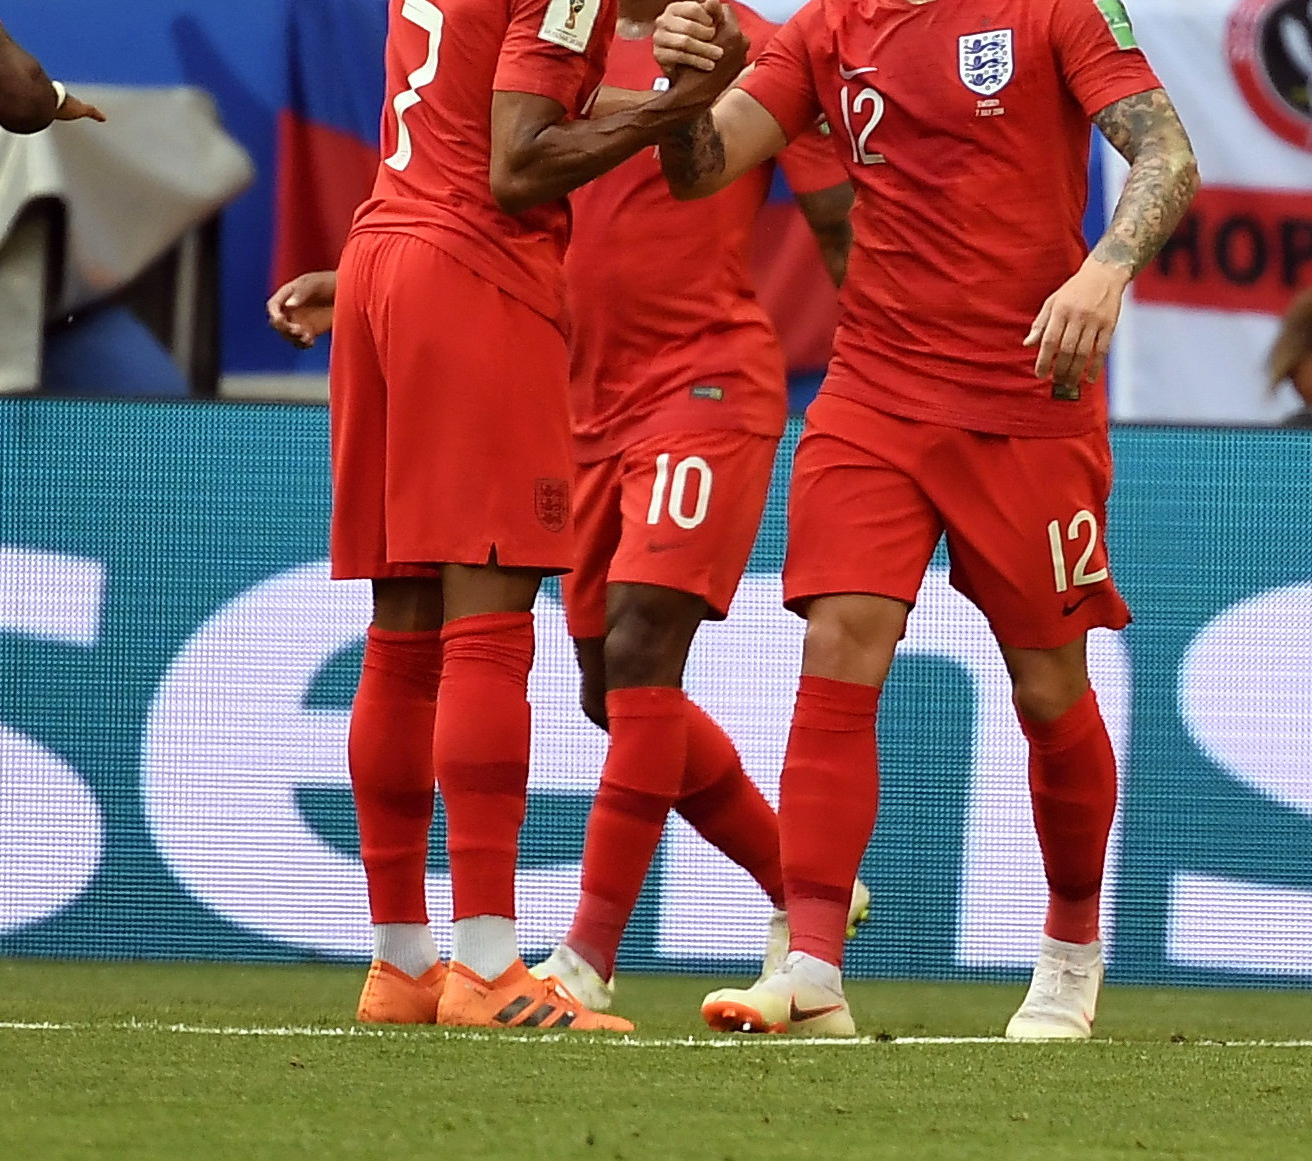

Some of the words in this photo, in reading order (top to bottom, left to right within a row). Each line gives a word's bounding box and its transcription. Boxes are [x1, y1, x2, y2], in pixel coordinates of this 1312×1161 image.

[841, 86, 886, 165] 12
[646, 452, 713, 530] 10
[1047, 509, 1109, 593] 12
